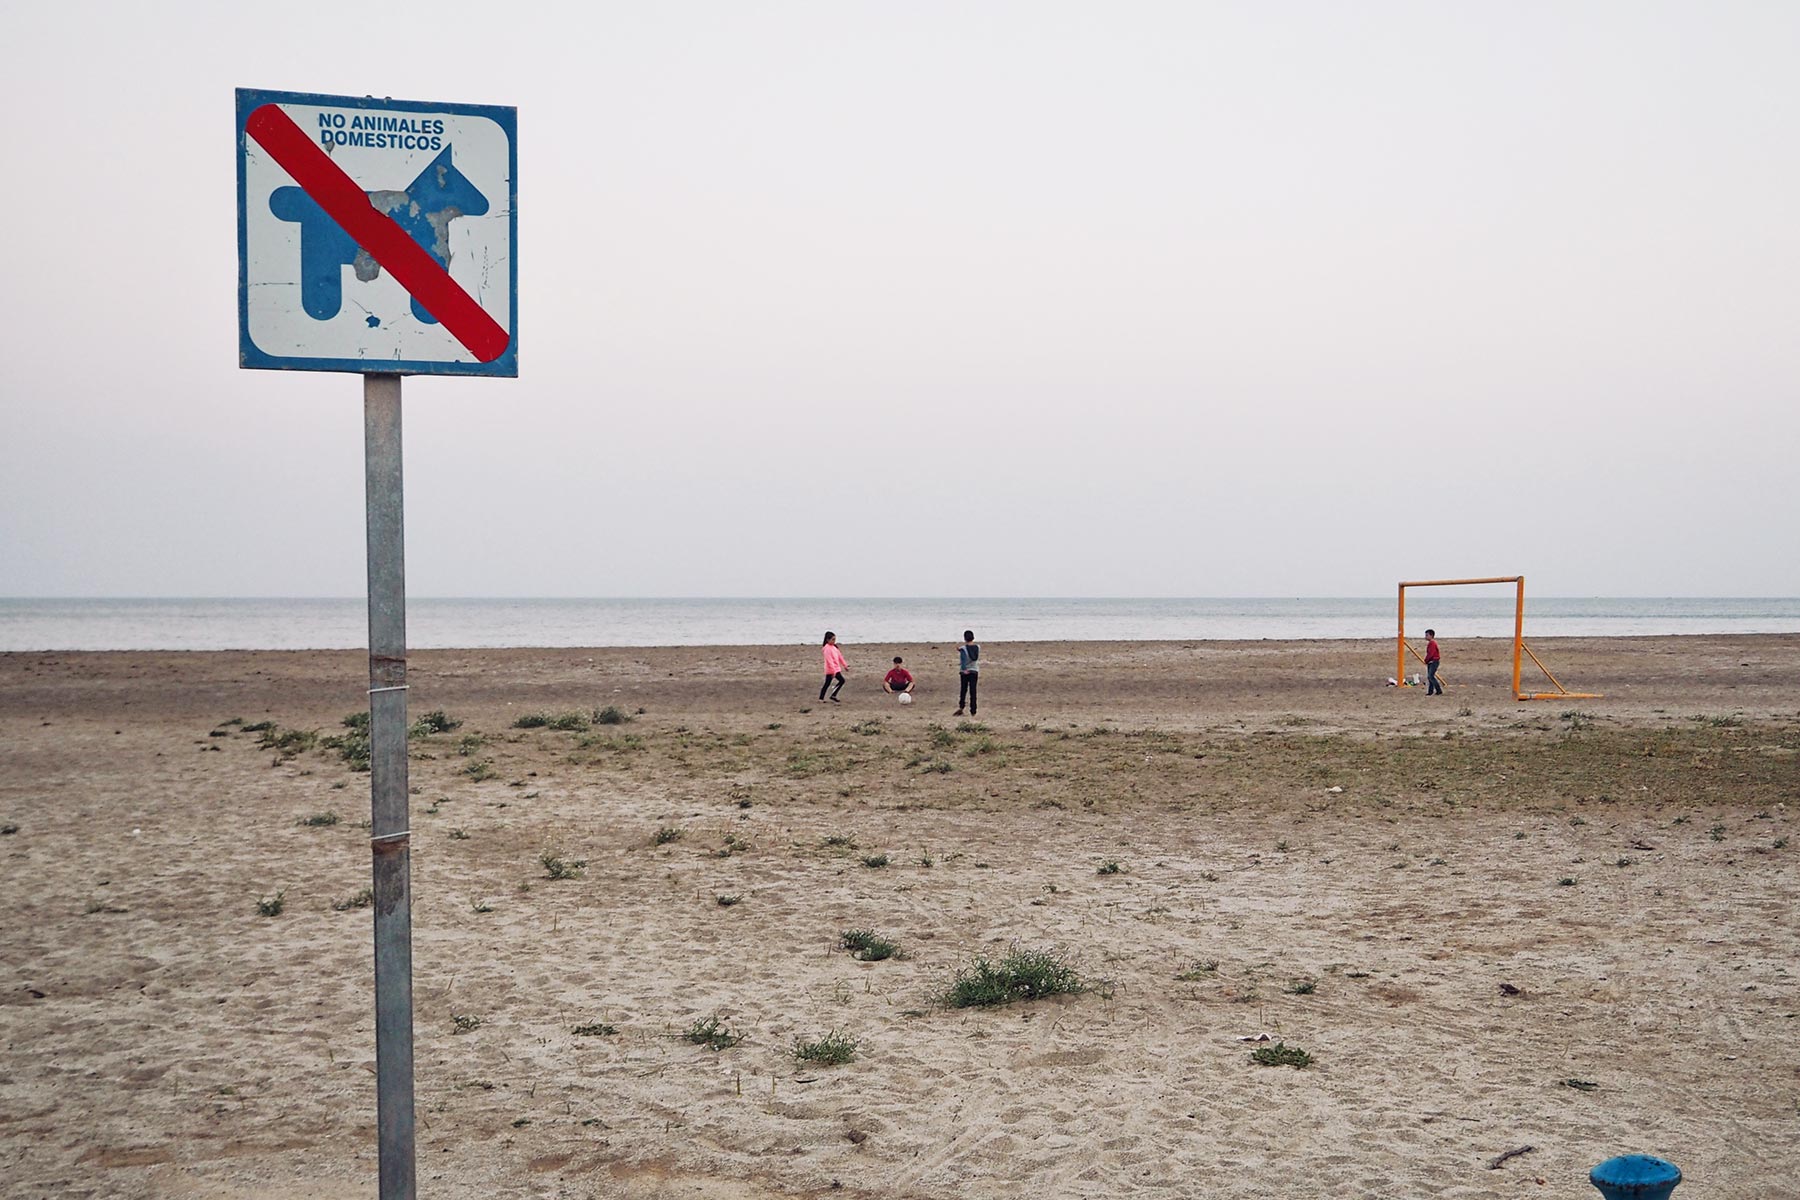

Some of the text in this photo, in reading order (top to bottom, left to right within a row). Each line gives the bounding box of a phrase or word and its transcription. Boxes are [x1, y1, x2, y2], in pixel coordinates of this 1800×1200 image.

[319, 113, 444, 135] NO ANIMALES
[321, 130, 441, 150] DOMESTICOS
